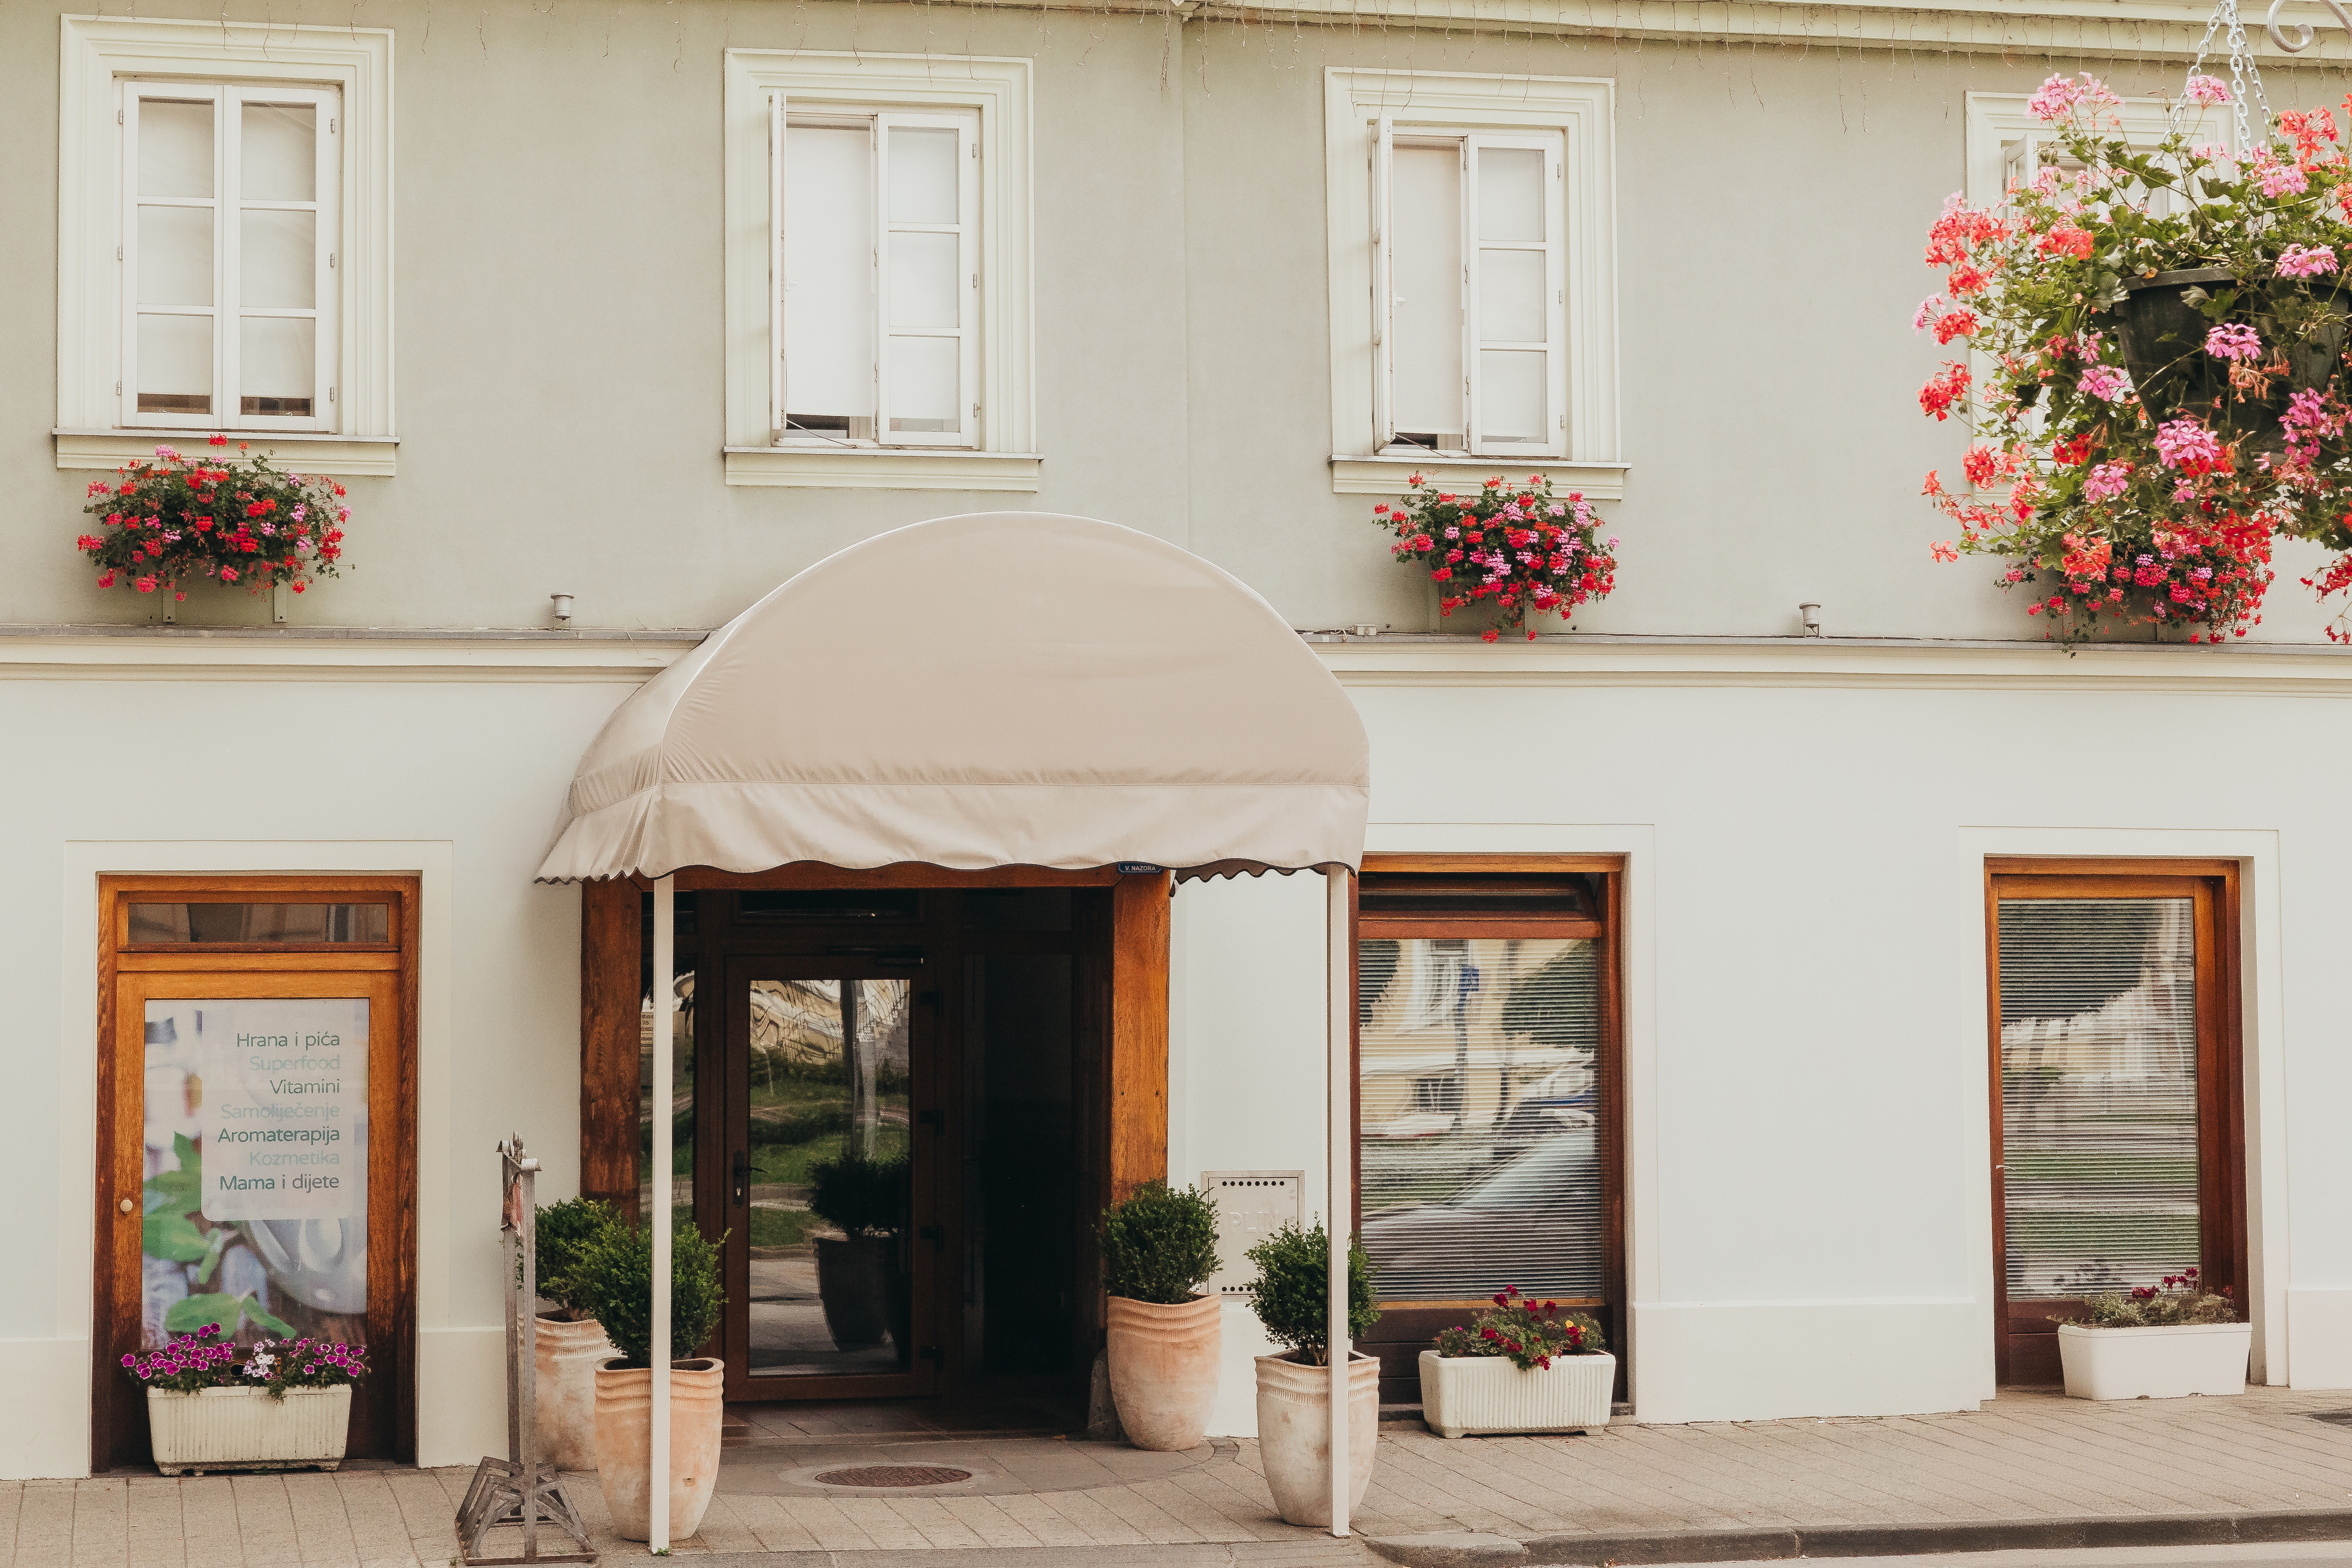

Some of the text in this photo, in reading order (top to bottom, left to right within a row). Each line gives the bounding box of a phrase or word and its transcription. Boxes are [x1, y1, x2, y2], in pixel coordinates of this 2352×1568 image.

[237, 1030, 340, 1051] Hrana i pića
[249, 1055, 341, 1074] Superfood
[270, 1078, 340, 1094] Vitamini
[221, 1102, 340, 1121] Samoliječenje
[218, 1126, 340, 1146] Aromaterapija
[249, 1151, 340, 1166] Kozmetika
[220, 1173, 340, 1194] Mama i dijete
[1229, 1211, 1279, 1233] PLIN
